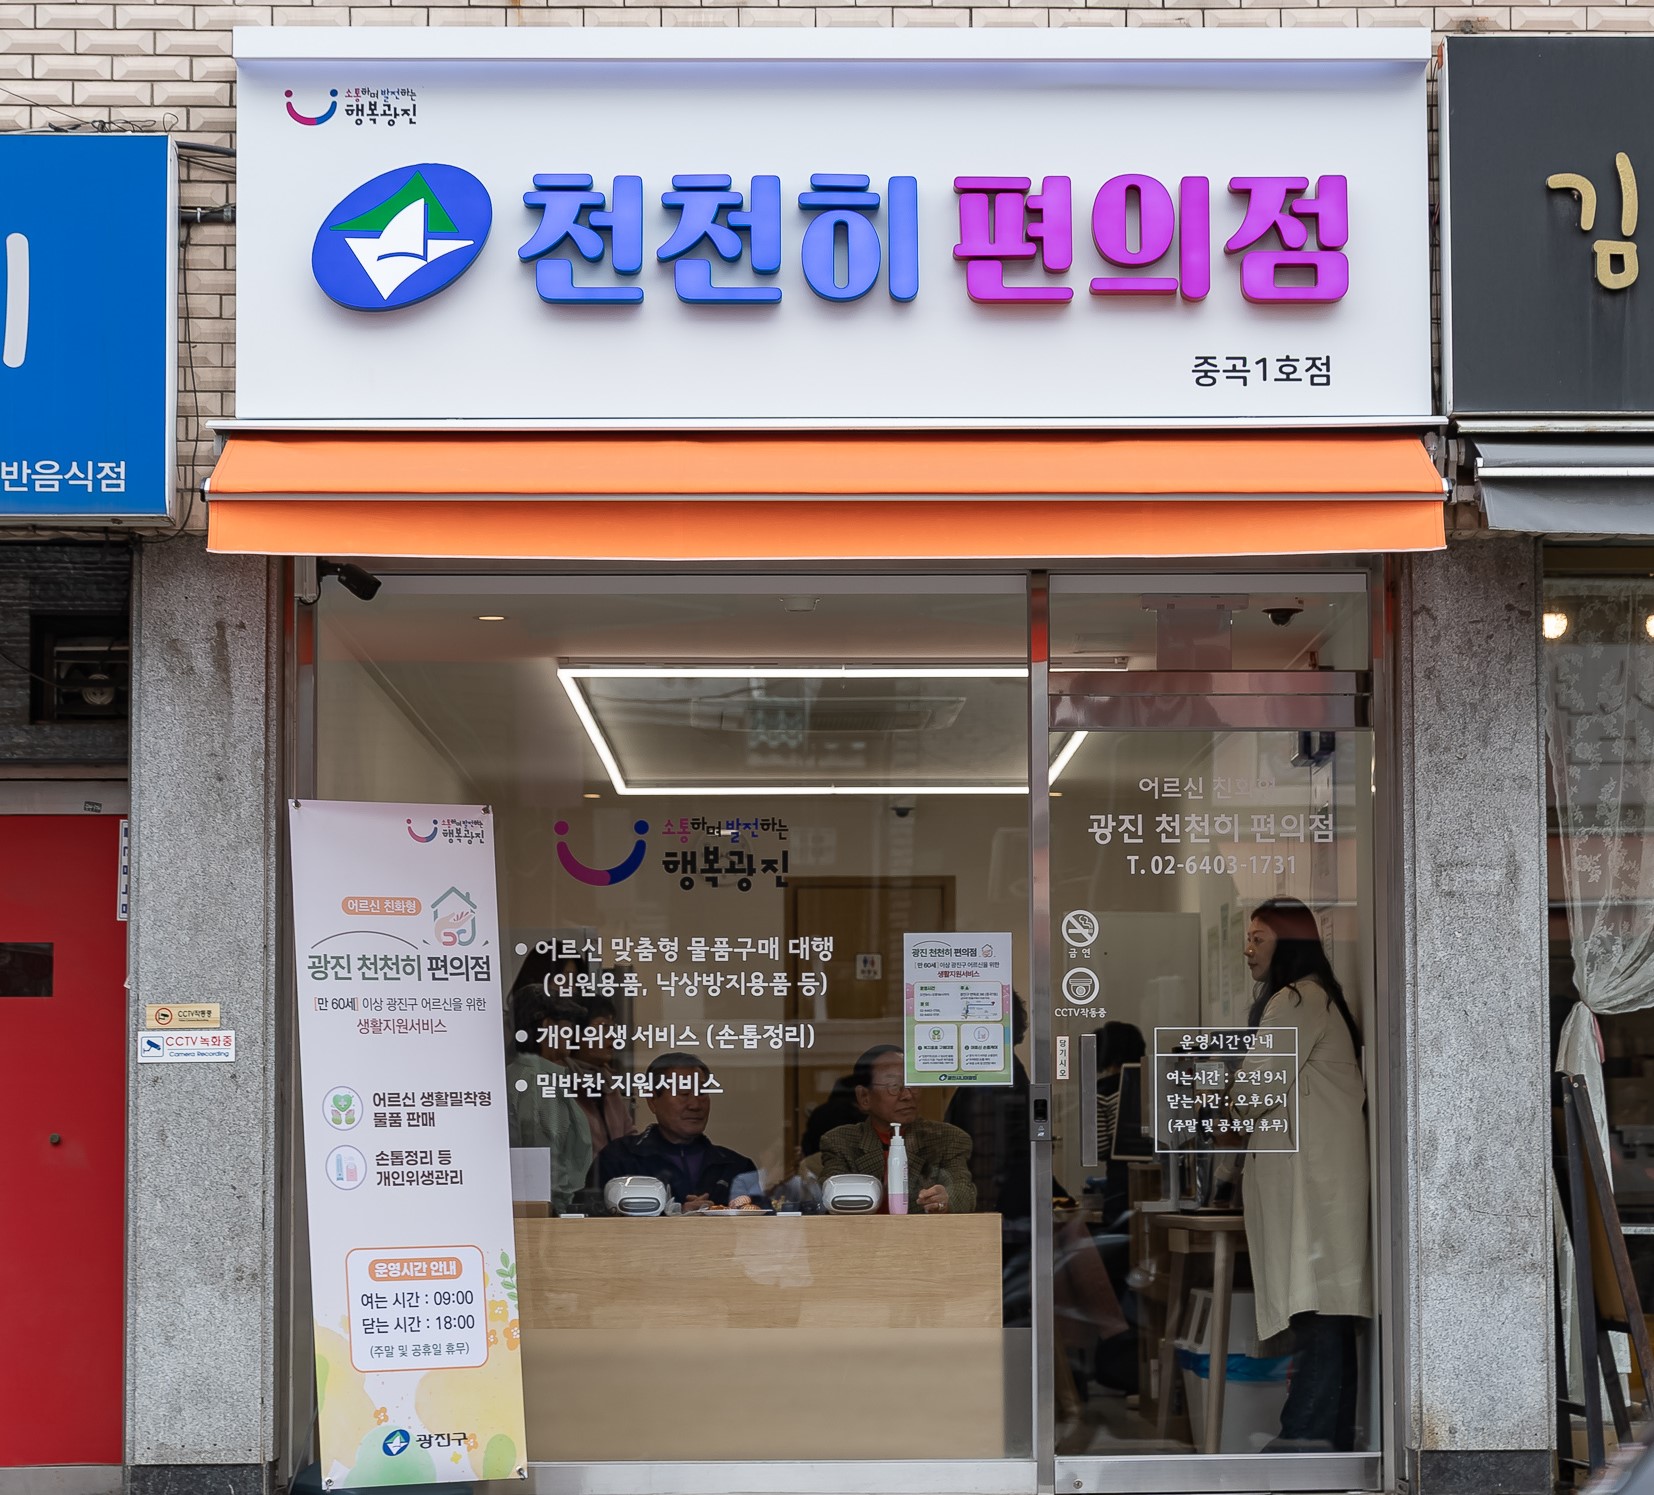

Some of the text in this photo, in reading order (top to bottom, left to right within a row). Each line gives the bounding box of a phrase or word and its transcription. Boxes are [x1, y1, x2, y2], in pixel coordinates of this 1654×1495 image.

[345, 87, 417, 103] 소통하며 발전하는
[345, 101, 417, 126] 행복광진
[1547, 152, 1639, 289] 김
[518, 173, 1350, 304] 천천히 편의점
[1191, 355, 1332, 387] 중곡1호점
[1, 460, 126, 493] 반음식점
[1138, 776, 1203, 799] 어르신
[442, 827, 484, 844] 행복광진
[662, 817, 789, 844] 소통하며 발전하는
[1088, 814, 1333, 845] 광진 천천히 편의점
[662, 846, 789, 892] 행복광진
[347, 899, 417, 913] 어르신 친화형
[536, 937, 834, 963] 어르신 맞춤형 물품구매 대행
[912, 948, 977, 957] 광진 천천히 편의점
[307, 954, 491, 982] 광진 천천히 편의점
[937, 970, 980, 978] 생활지원서비스
[543, 972, 828, 997] (입원용품, 낙상방지용품 등)
[362, 997, 383, 1011] 이상
[386, 997, 418, 1011] 광진구
[421, 997, 462, 1011] 어르신을
[465, 997, 486, 1011] 위한
[1054, 1008, 1107, 1018] CCTV작동중
[357, 1018, 447, 1035] 생활지원서비스
[706, 1024, 815, 1050] (손톱정리)
[1059, 1040, 1067, 1077] 당기시오
[536, 1072, 724, 1098] 밑반찬 지원서비스
[373, 1091, 492, 1108] 어르신 생활밀착형
[373, 1112, 435, 1128] 물품 판매
[1168, 1118, 1288, 1133] (주말 및 공휴일 휴무)
[375, 1150, 452, 1167] 손톱정리 등
[376, 1170, 463, 1186] 개인위생관리
[374, 1260, 457, 1278] 운영시간 안내
[361, 1293, 388, 1309] 여는
[392, 1291, 420, 1308] 시간
[433, 1290, 474, 1306] 09:00
[362, 1317, 389, 1334] 닫는
[394, 1316, 421, 1333] 시간
[435, 1314, 475, 1330] 18:00
[370, 1342, 470, 1359] (주말 및 공휴일 휴무)
[416, 1432, 468, 1449] 광진구
